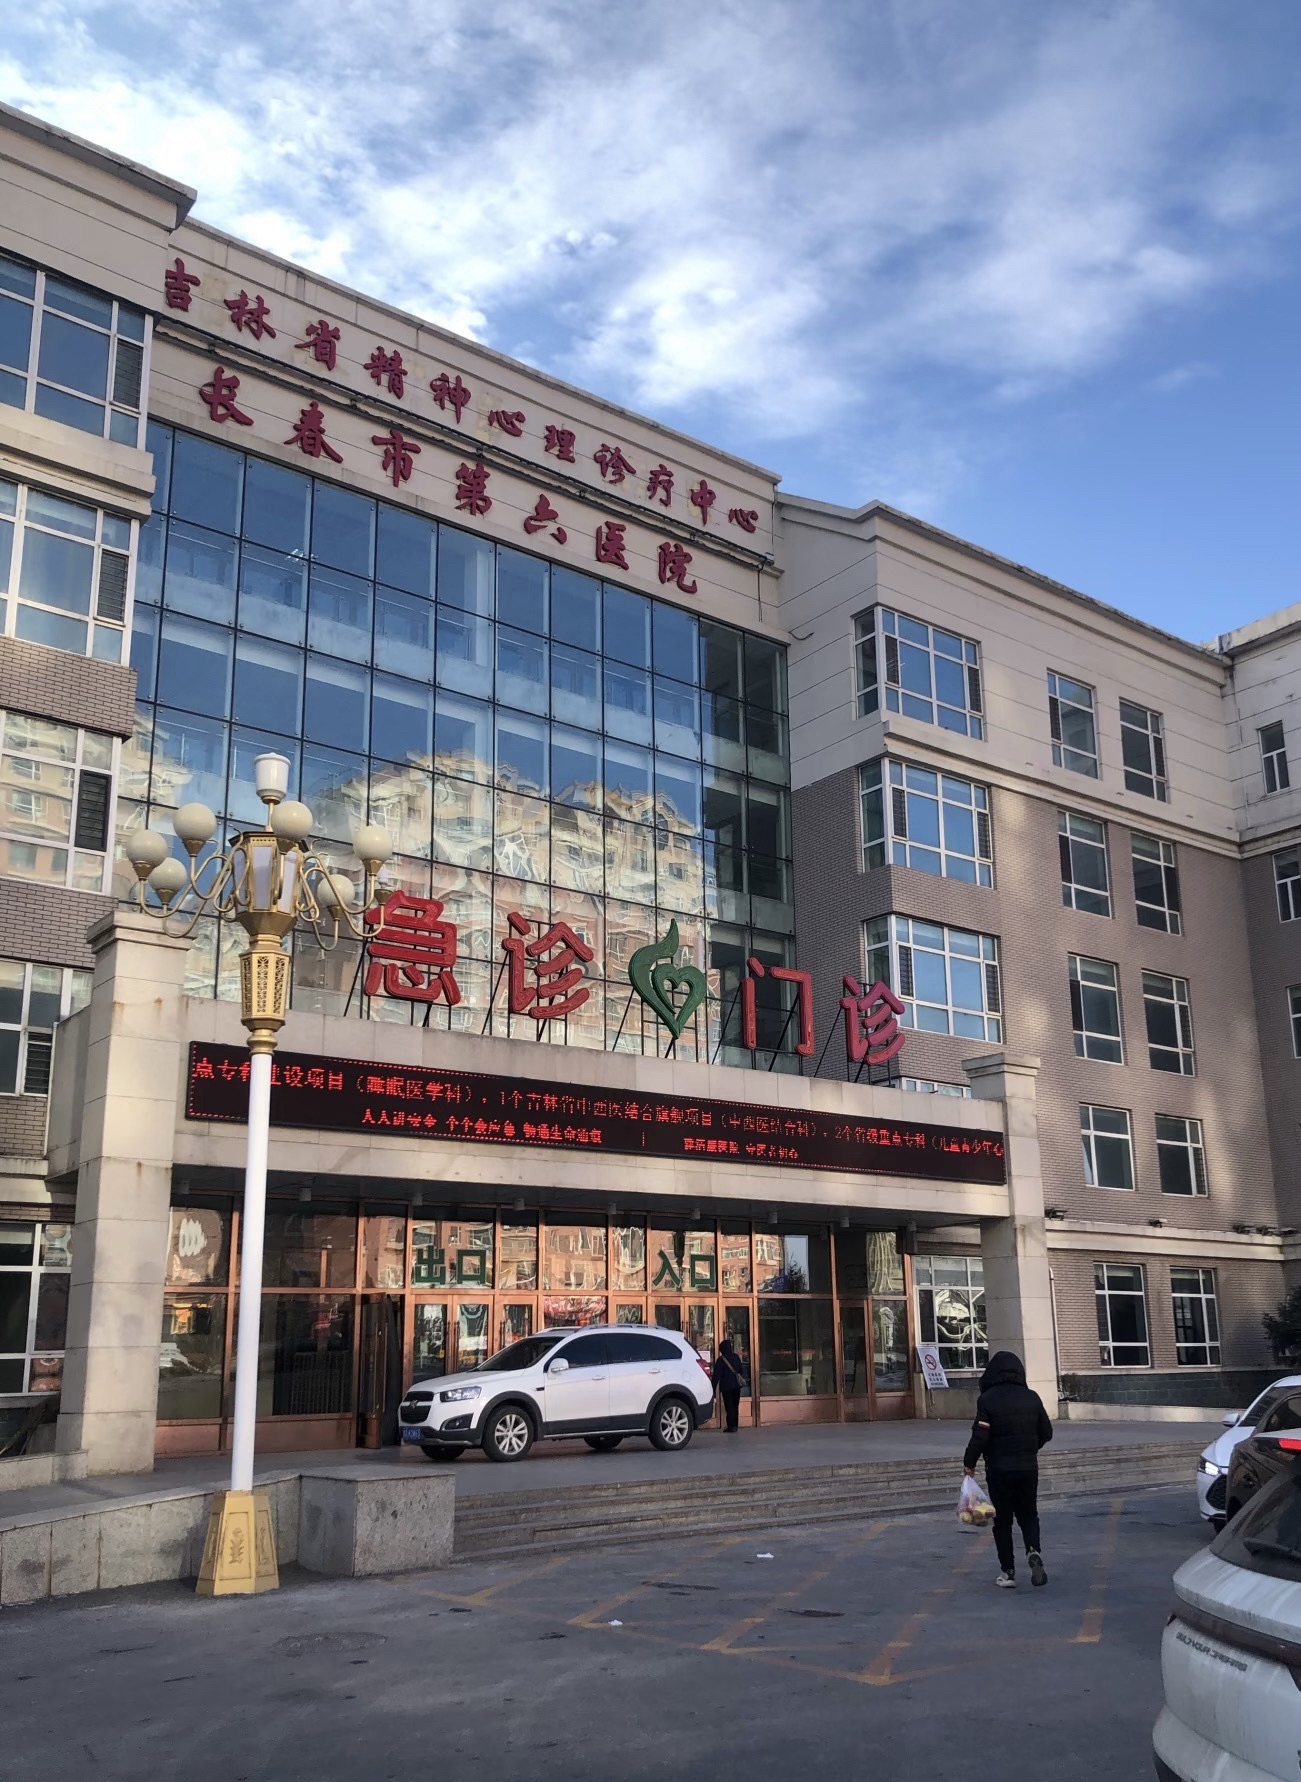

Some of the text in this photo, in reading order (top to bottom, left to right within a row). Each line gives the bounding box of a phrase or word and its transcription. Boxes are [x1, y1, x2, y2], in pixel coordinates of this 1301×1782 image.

[165, 257, 759, 533] 吉林省精神心理诊疗中心
[199, 366, 698, 594] 长春市第六医院
[364, 889, 906, 1065] 急诊 门诊
[415, 1245, 716, 1288] 出口 入口
[1192, 1640, 1211, 1656] YOUR
